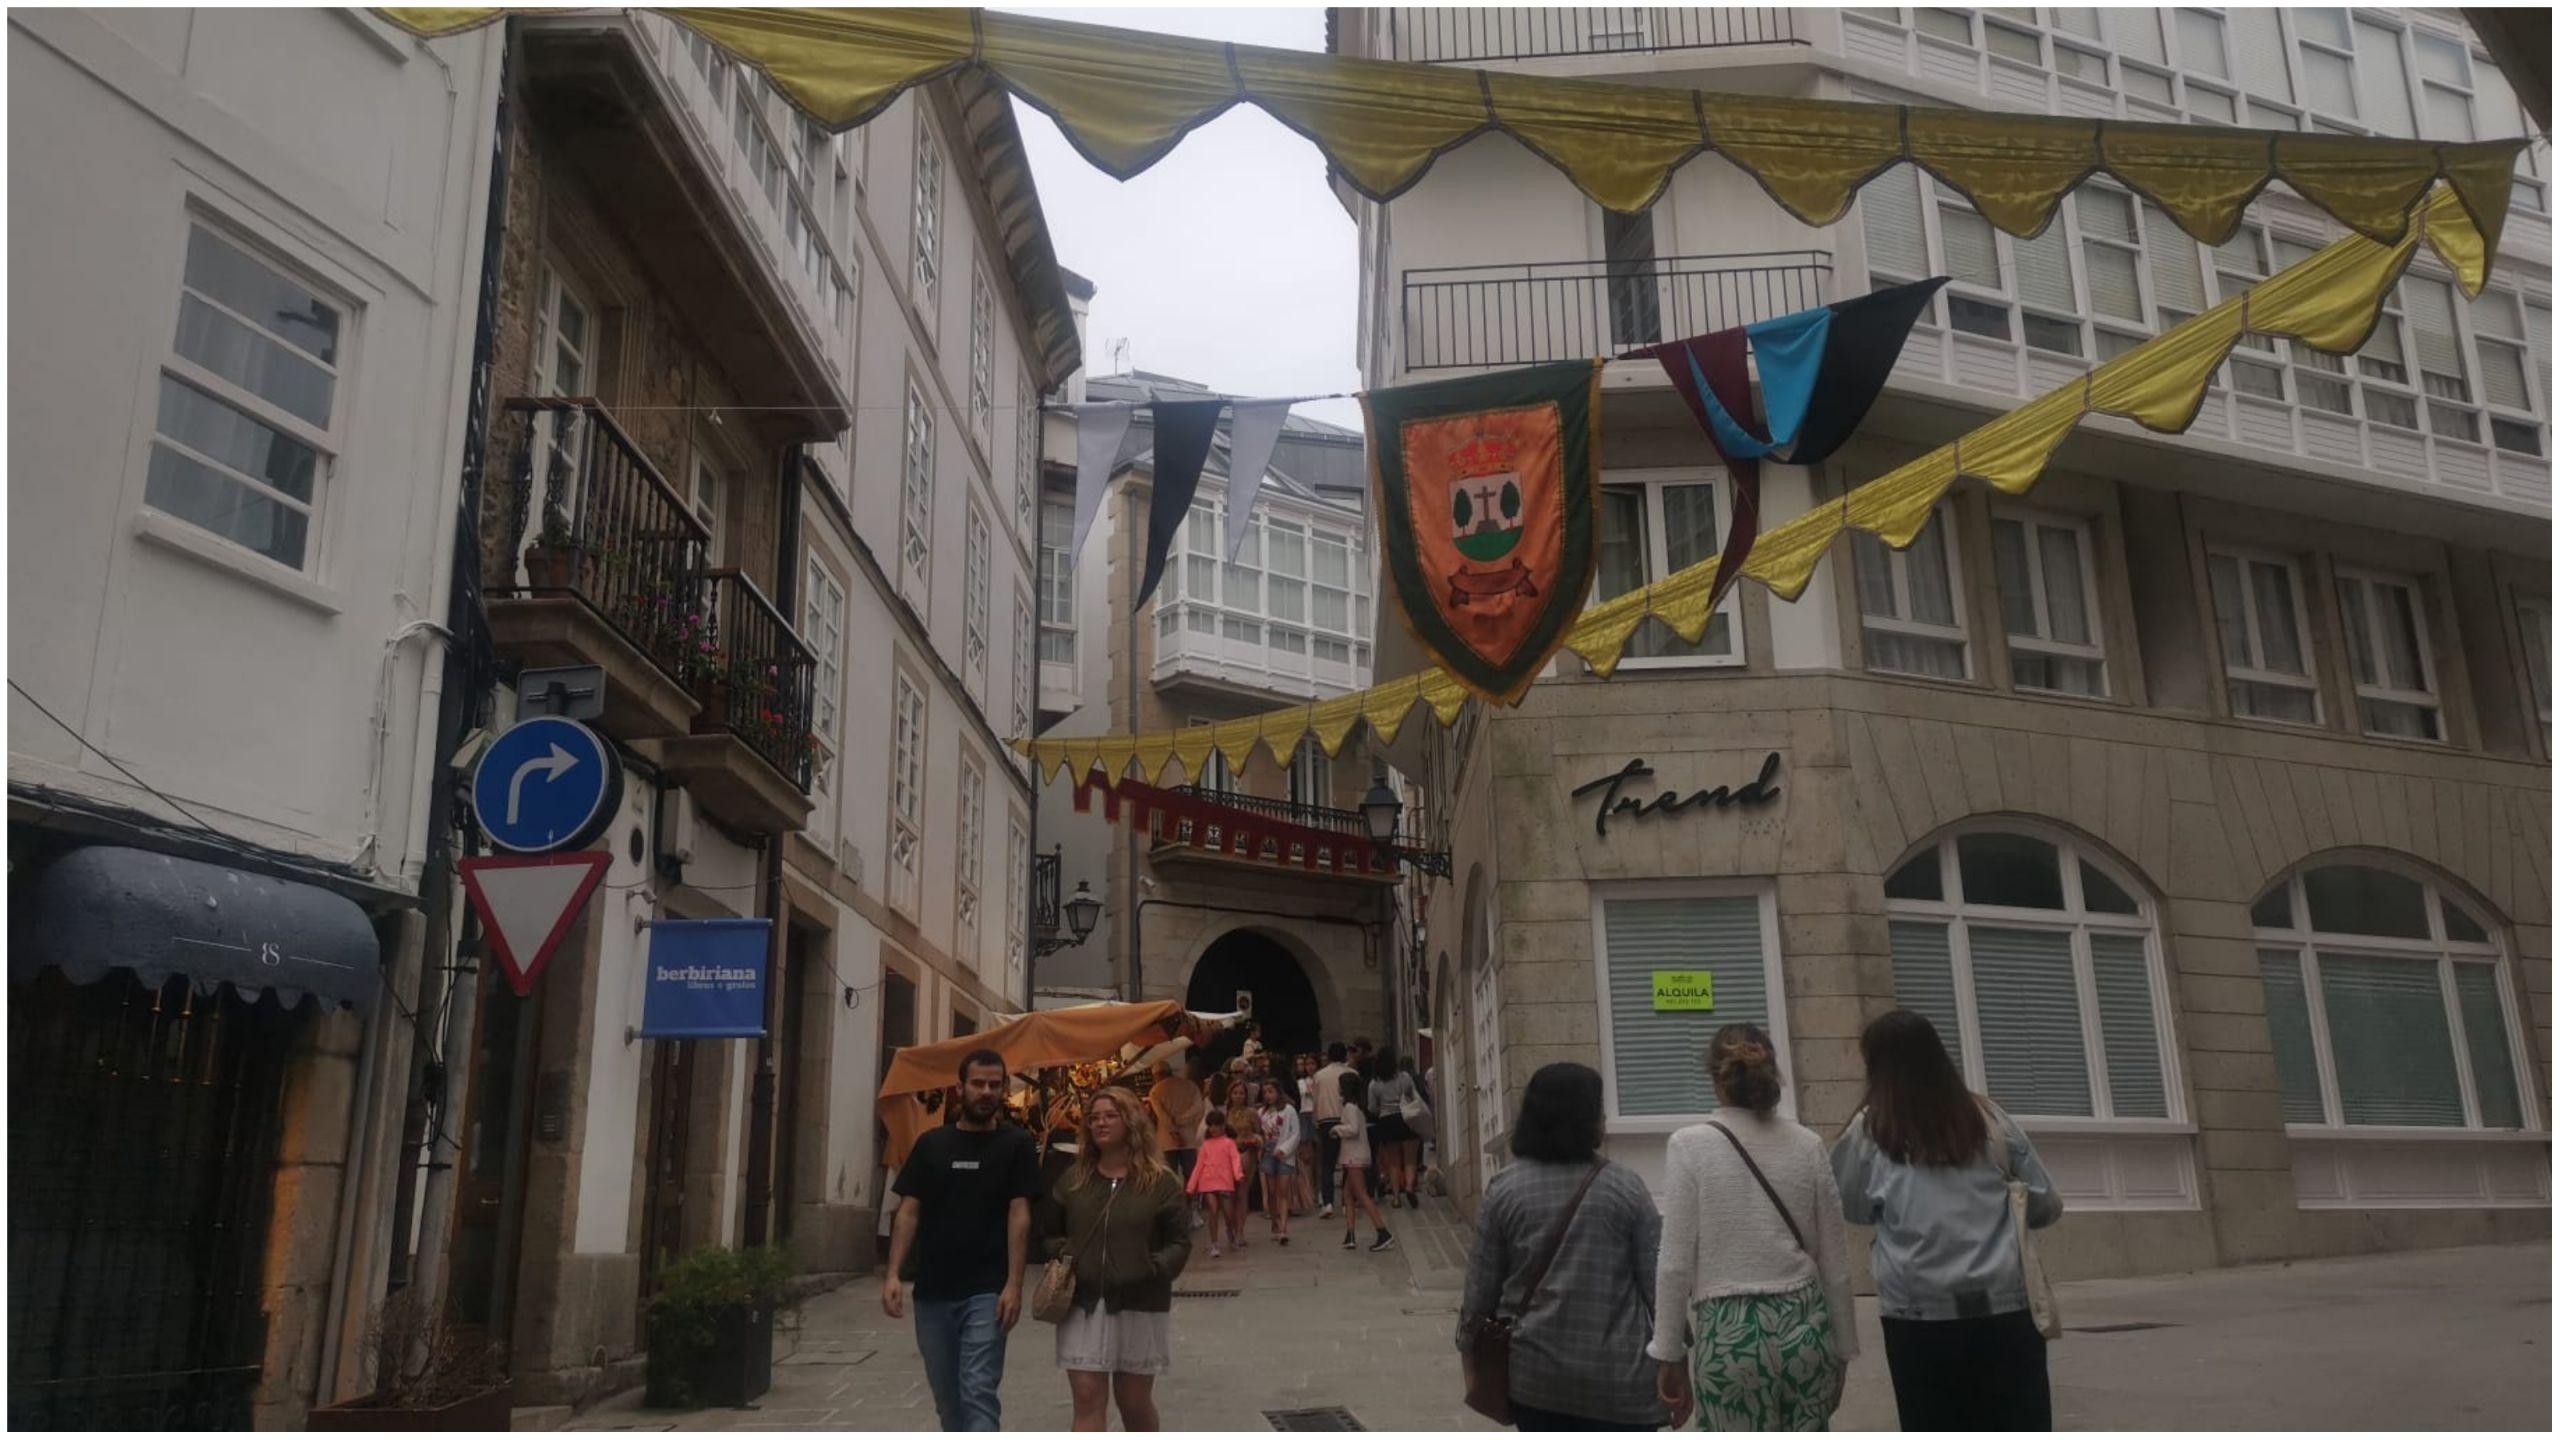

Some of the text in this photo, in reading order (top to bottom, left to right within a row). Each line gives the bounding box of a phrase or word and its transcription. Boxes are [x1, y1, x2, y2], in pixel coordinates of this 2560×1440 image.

[1571, 751, 1781, 837] Trend
[655, 965, 756, 981] berbiriana
[1657, 987, 1709, 997] ALQUILA
